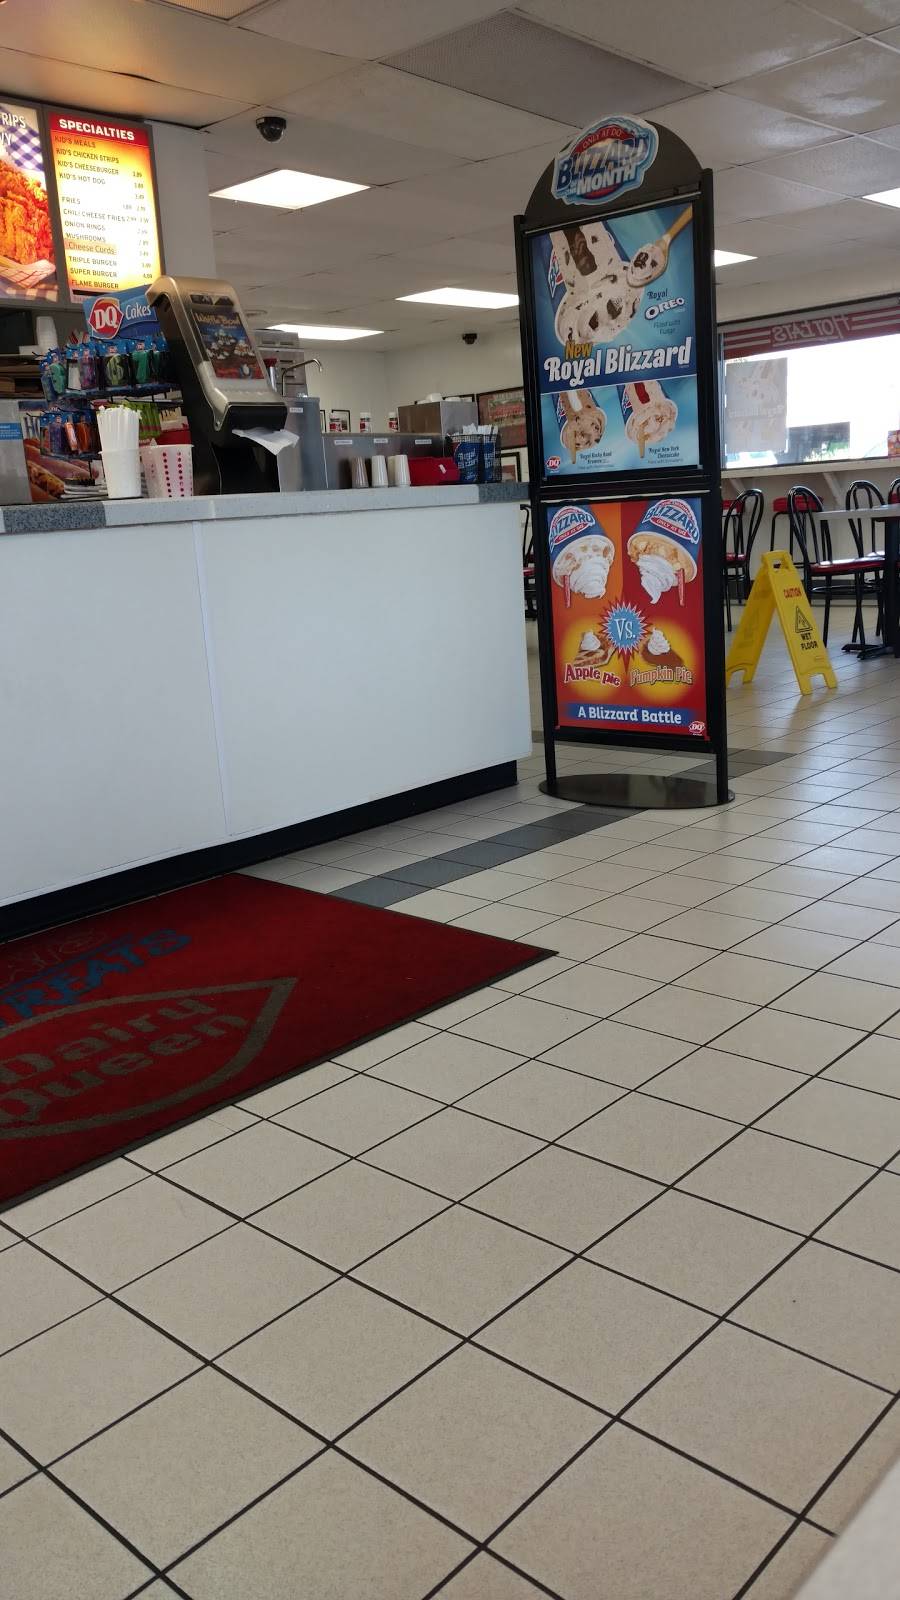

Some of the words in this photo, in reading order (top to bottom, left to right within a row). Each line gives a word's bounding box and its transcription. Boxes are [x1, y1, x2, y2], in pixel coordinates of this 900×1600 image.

[0, 112, 26, 129] RIPS
[59, 118, 135, 141] SPECIALTIES
[54, 135, 72, 145] KID'S
[73, 138, 96, 149] MEALS
[56, 147, 71, 156] KID'S
[73, 150, 98, 161] CHICKEN
[100, 154, 119, 164] STRIPS
[57, 159, 73, 169] KID'S
[75, 162, 119, 175] CHEESEBURGER
[59, 171, 76, 181] KID'S
[78, 175, 89, 183] HOT
[93, 177, 106, 185] DOG
[576, 163, 637, 196] MONTH
[61, 196, 81, 205] FRIES
[81, 211, 106, 220] CHEESE
[107, 214, 126, 222] FRIES
[64, 220, 86, 229] ONION
[86, 222, 106, 231] RINGS
[65, 232, 106, 243] MUSHROOMS
[68, 241, 94, 252] Cheese
[68, 255, 91, 264] TRIPLE
[92, 258, 117, 267] BURGER
[70, 267, 91, 276] SUPER
[92, 270, 118, 278] BURGER
[71, 279, 92, 288] FLAME
[93, 281, 119, 289] BURGER
[647, 288, 668, 301] Royal
[645, 297, 685, 320] OREO
[94, 305, 119, 330] DQ
[125, 302, 152, 320] Cakes
[565, 340, 593, 360] New
[543, 349, 602, 387] Royal
[604, 336, 692, 375] Blizzard
[549, 460, 559, 468] DQ
[801, 632, 812, 641] WET
[801, 640, 819, 651] FLOOR
[564, 663, 601, 683] Apple
[601, 671, 621, 687] pie
[630, 665, 673, 686] Pumpkin
[674, 666, 693, 685] Pie
[577, 706, 587, 719] A
[589, 706, 638, 721] Blizzard
[641, 709, 682, 725] Battle
[692, 723, 704, 731] DQ
[0, 929, 192, 1027] REATS
